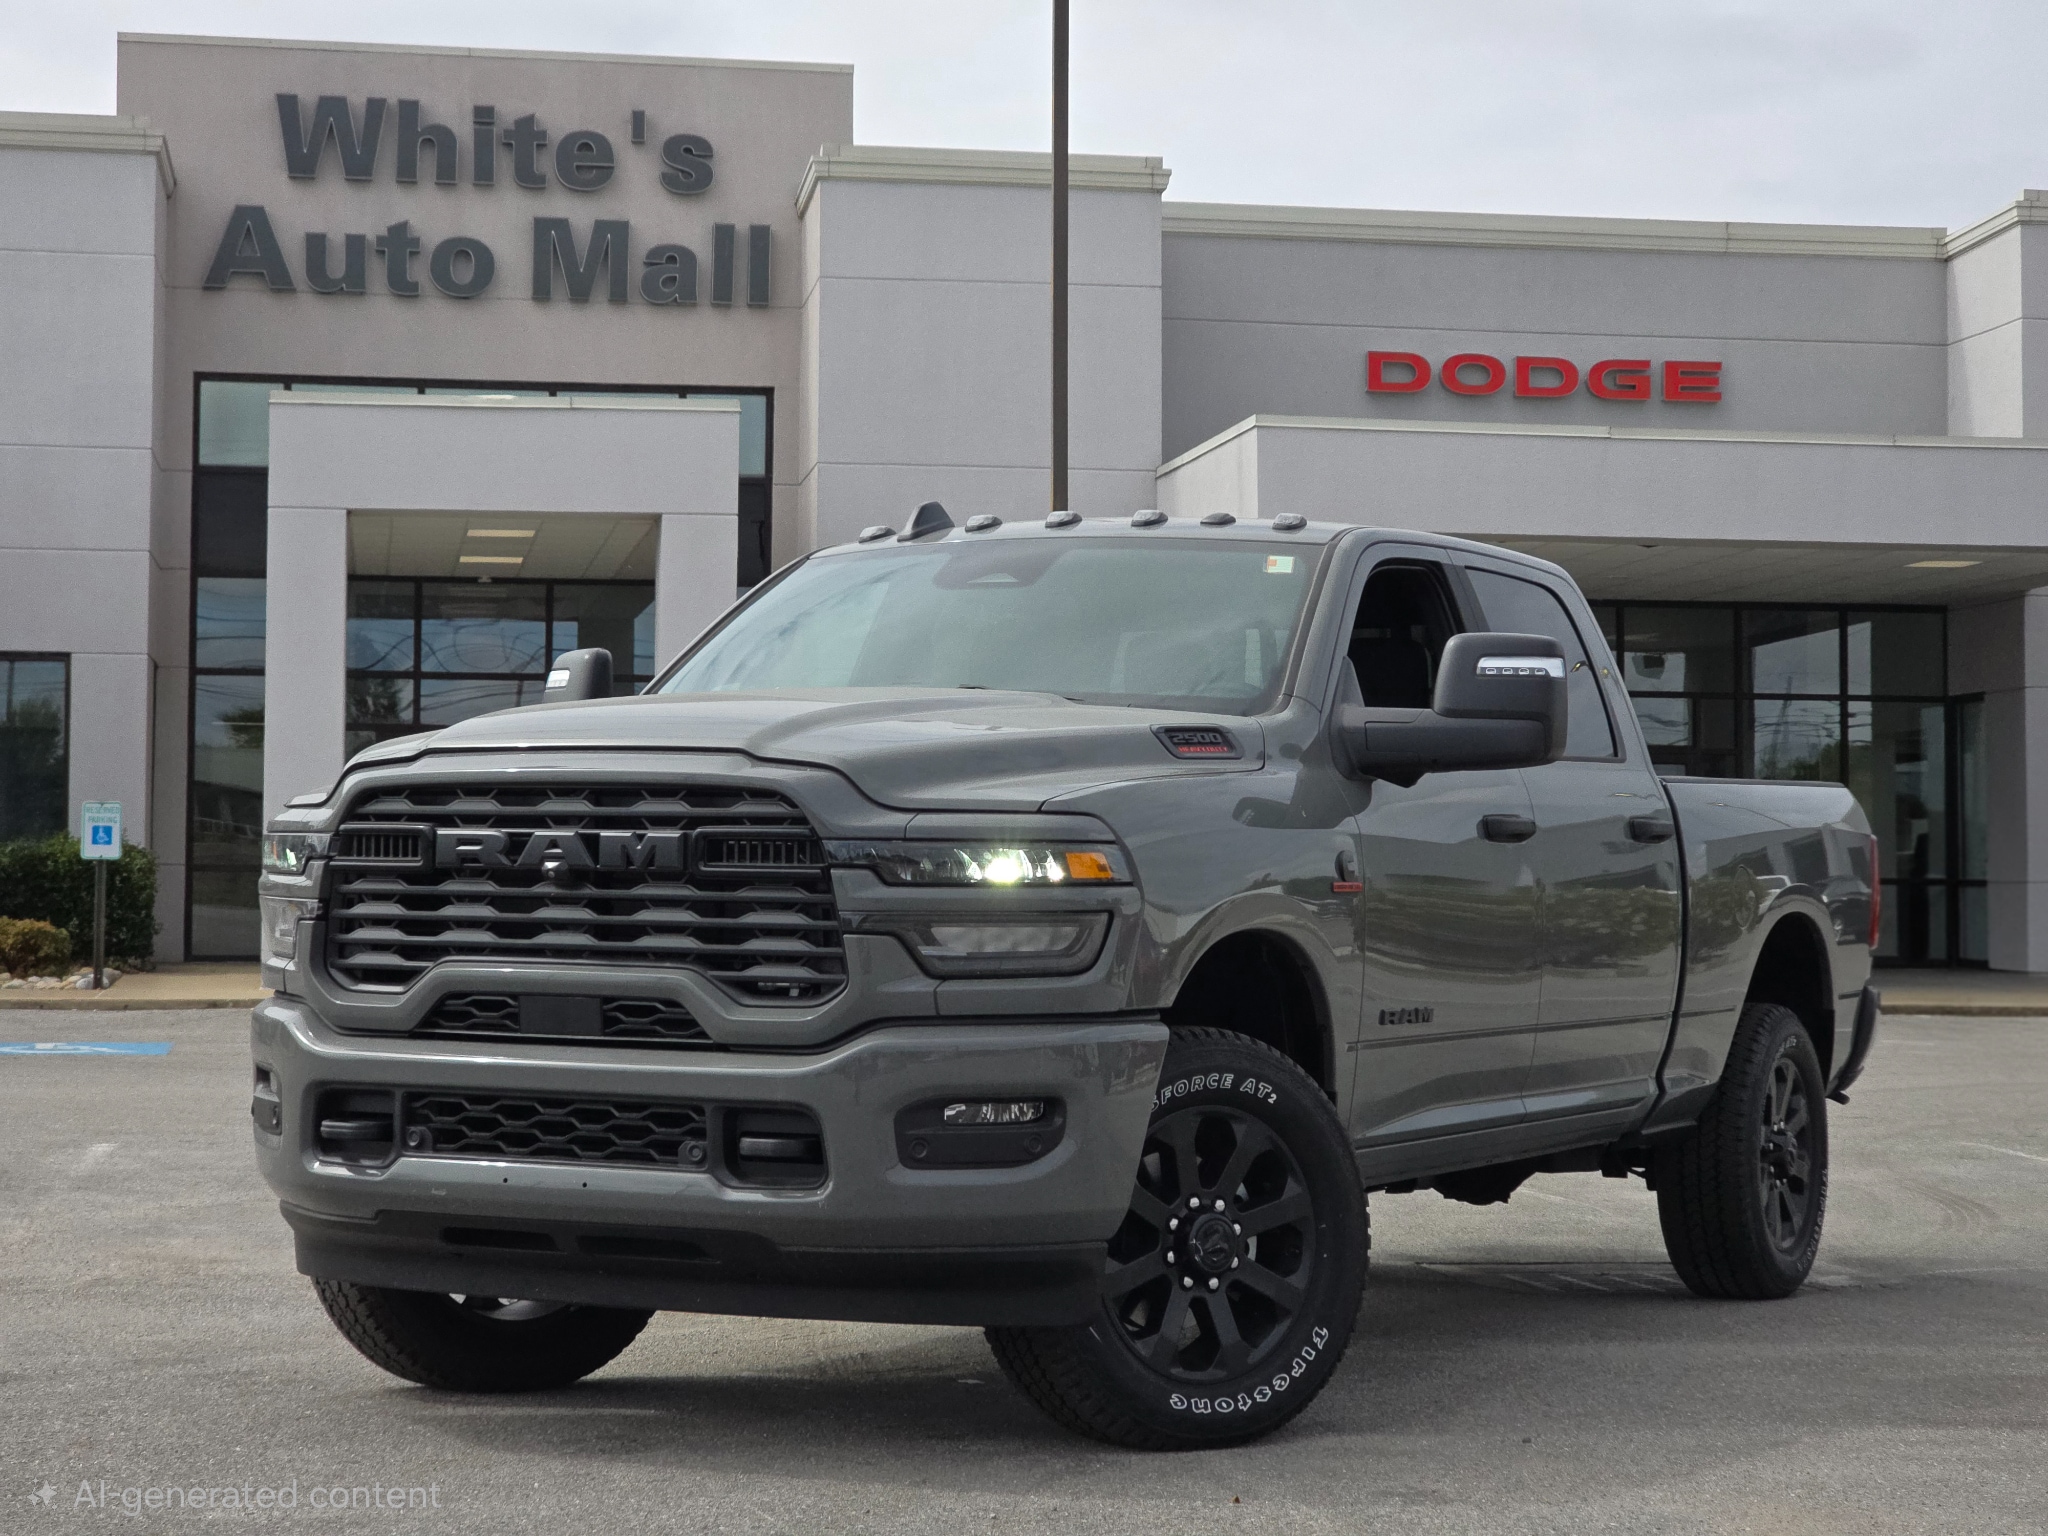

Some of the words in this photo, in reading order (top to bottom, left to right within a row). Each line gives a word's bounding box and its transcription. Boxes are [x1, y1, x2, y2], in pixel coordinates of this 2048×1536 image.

[276, 93, 715, 195] White's
[203, 204, 496, 298] Auto
[532, 216, 772, 306] Mall
[1366, 350, 1723, 402] DODGE
[1172, 732, 1222, 743] 2500
[435, 829, 688, 869] RAM
[1378, 1006, 1434, 1025] RAM
